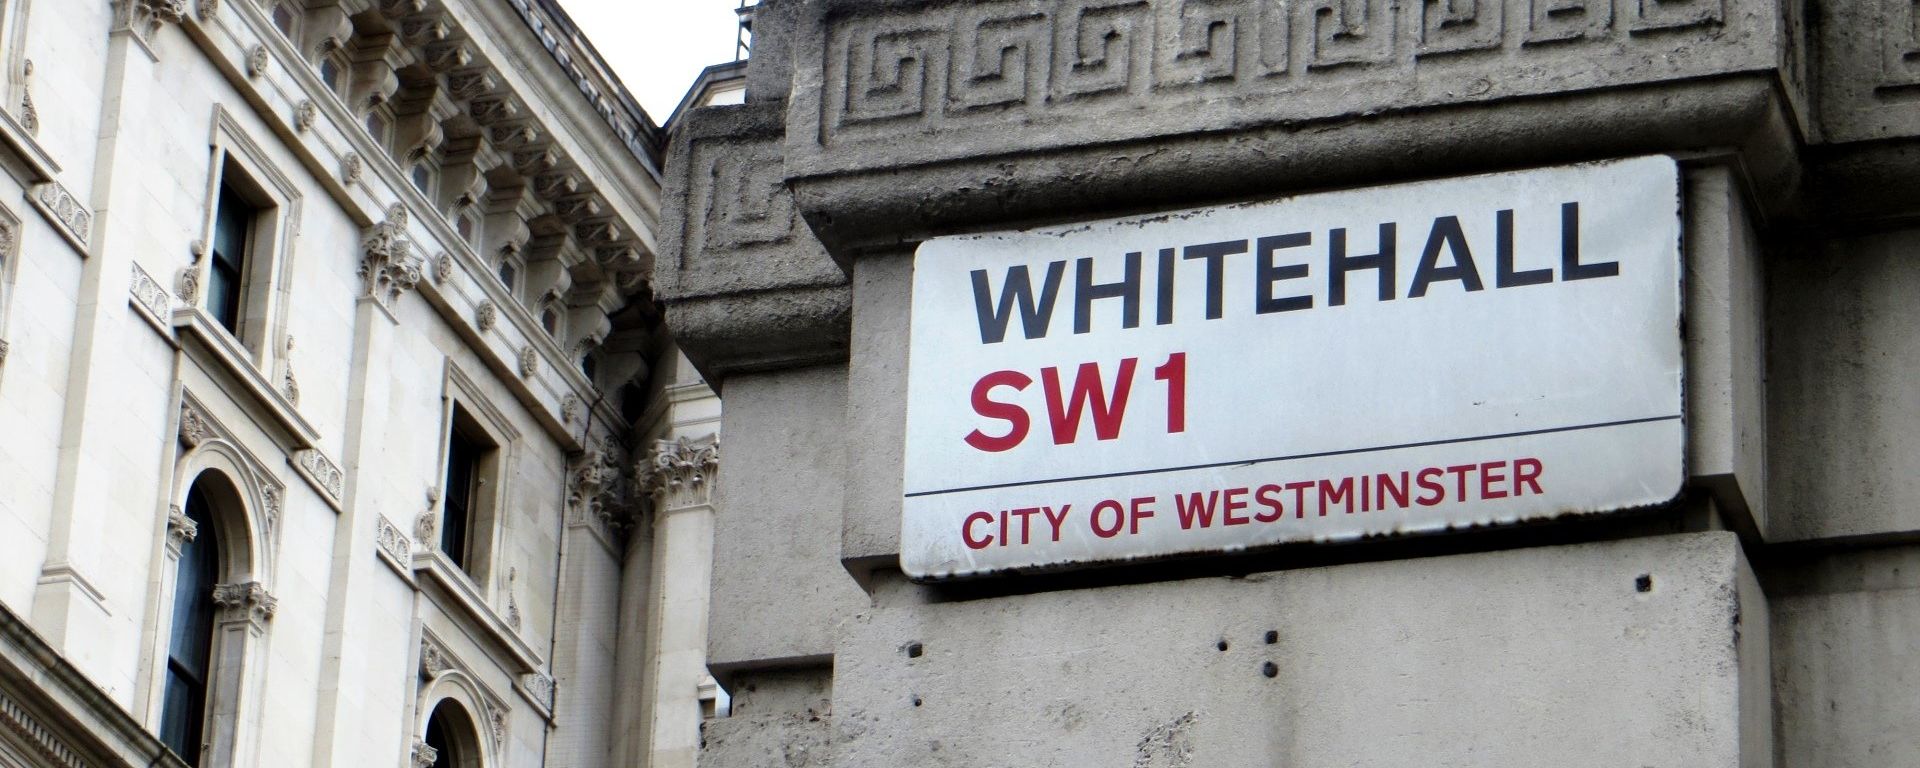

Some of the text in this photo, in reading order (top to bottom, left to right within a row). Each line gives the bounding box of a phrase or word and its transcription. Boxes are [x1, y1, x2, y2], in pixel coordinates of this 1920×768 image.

[970, 201, 1620, 345] WHITEHALL
[963, 352, 1187, 453] SW1
[962, 457, 1544, 550] CITY OF WESTMINSTER
